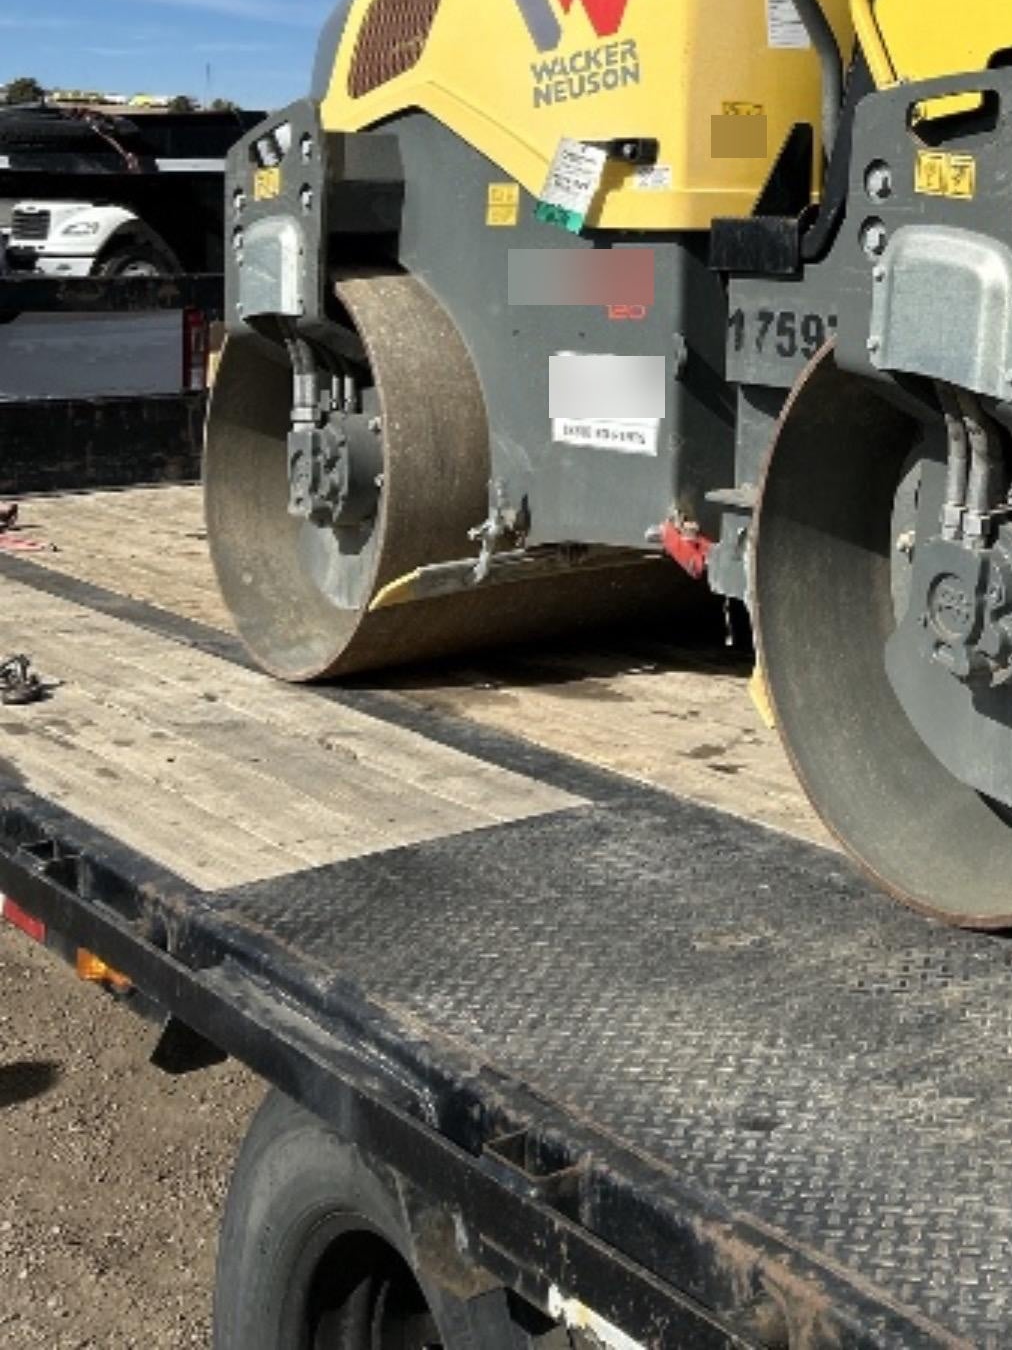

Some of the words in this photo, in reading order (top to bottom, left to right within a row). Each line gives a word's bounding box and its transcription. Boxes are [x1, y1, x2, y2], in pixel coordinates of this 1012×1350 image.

[530, 38, 638, 84] WACKER
[532, 62, 640, 108] NEUSON
[727, 308, 838, 361] 1759
